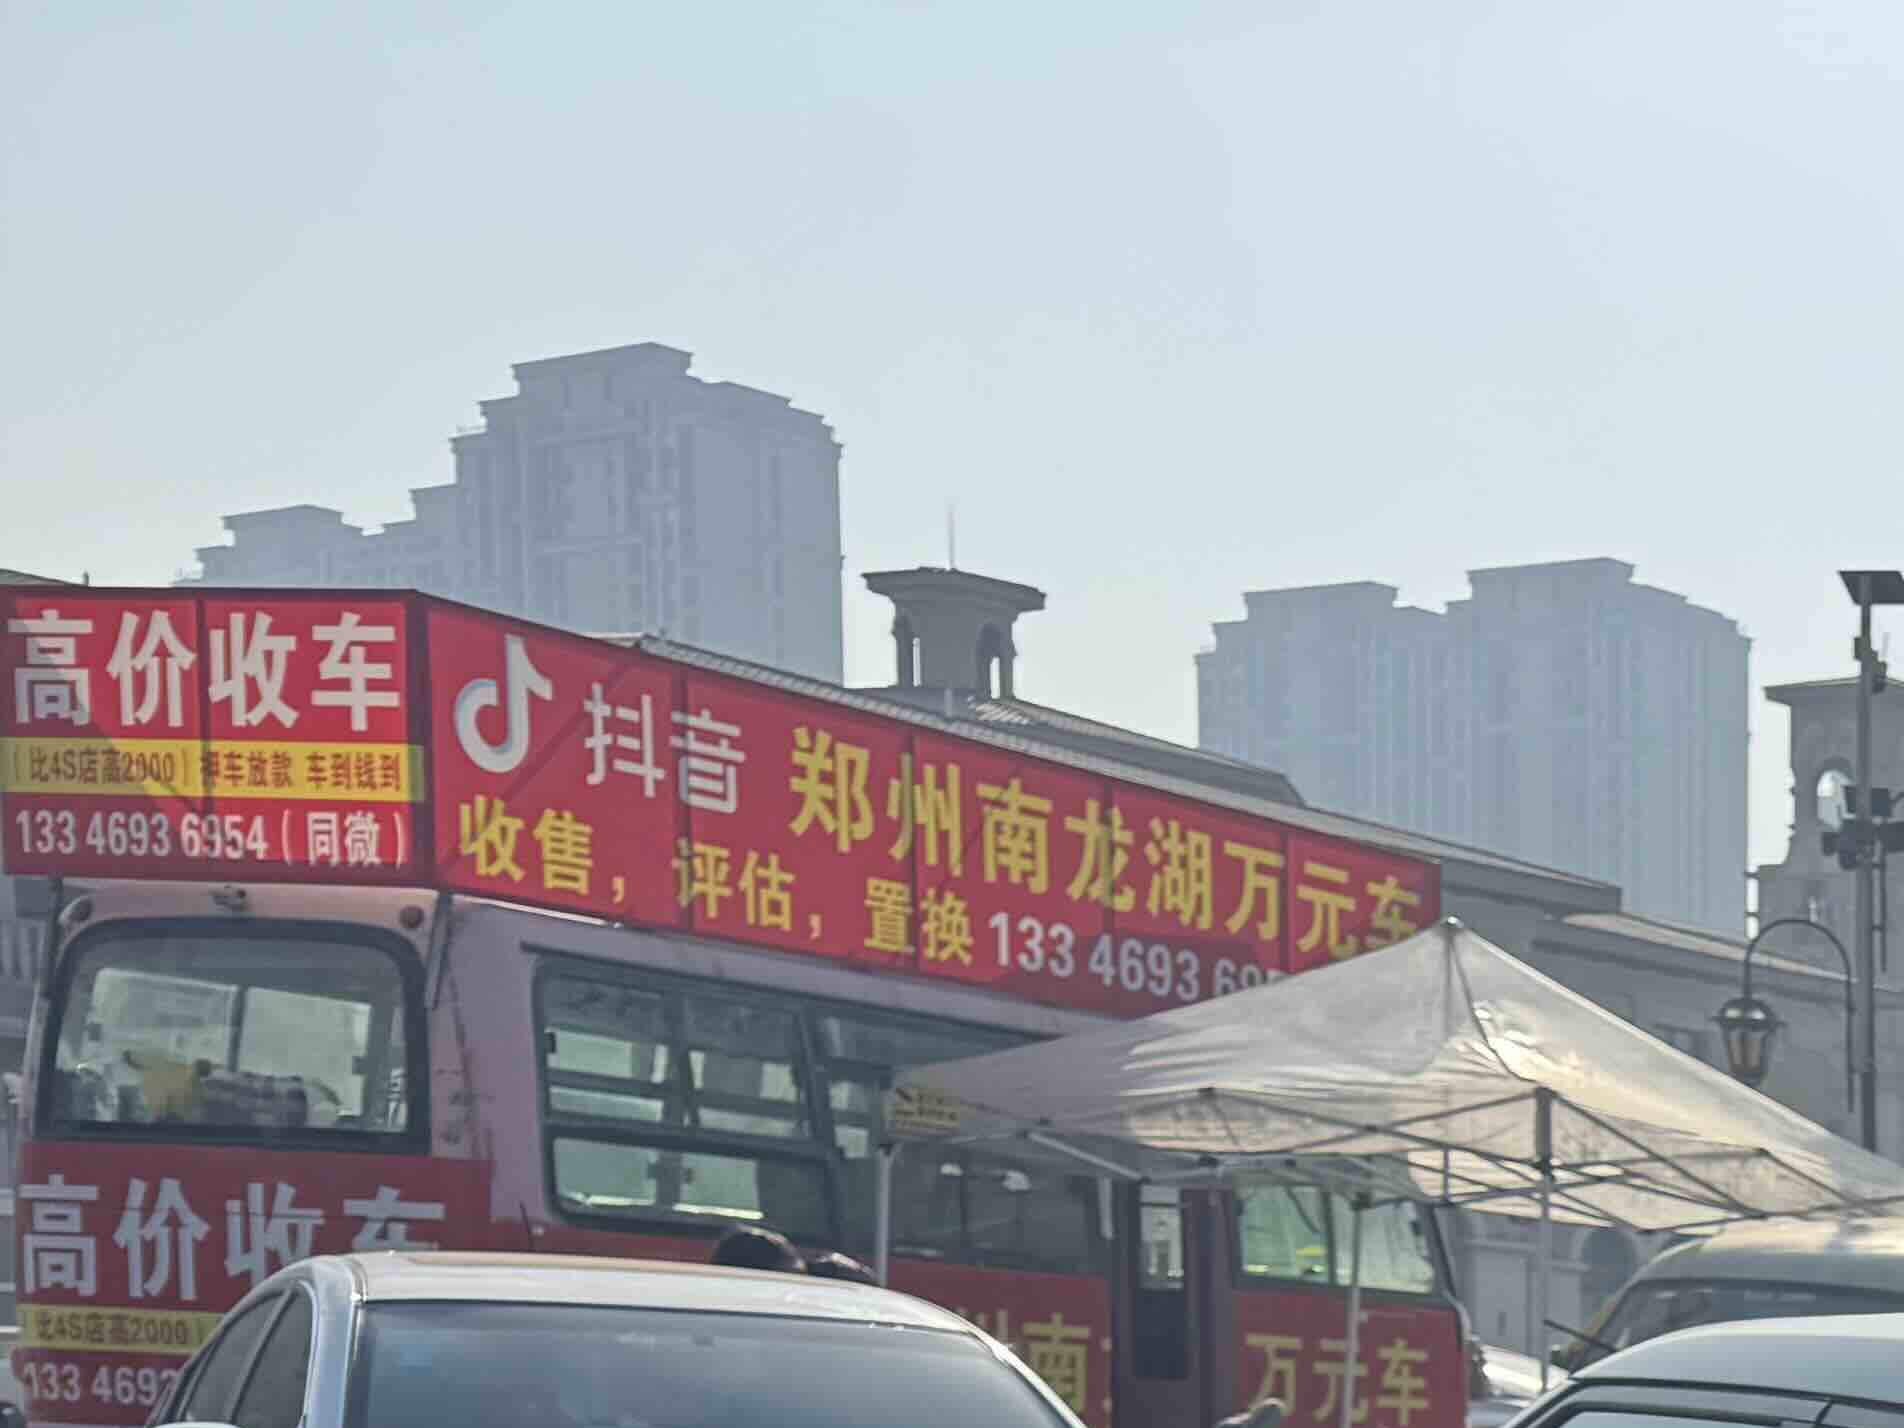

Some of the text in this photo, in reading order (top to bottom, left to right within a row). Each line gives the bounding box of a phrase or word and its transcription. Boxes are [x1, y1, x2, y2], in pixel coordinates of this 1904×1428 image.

[7, 609, 399, 732] 高价收车
[585, 684, 746, 815] 抖音
[15, 809, 76, 854] 133
[85, 811, 171, 857] 4693
[988, 912, 1075, 979] 133
[1088, 933, 1199, 1002] 4693
[19, 1173, 446, 1299] 高价收车
[22, 1361, 81, 1401] 133
[1246, 1334, 1428, 1426] 万元车
